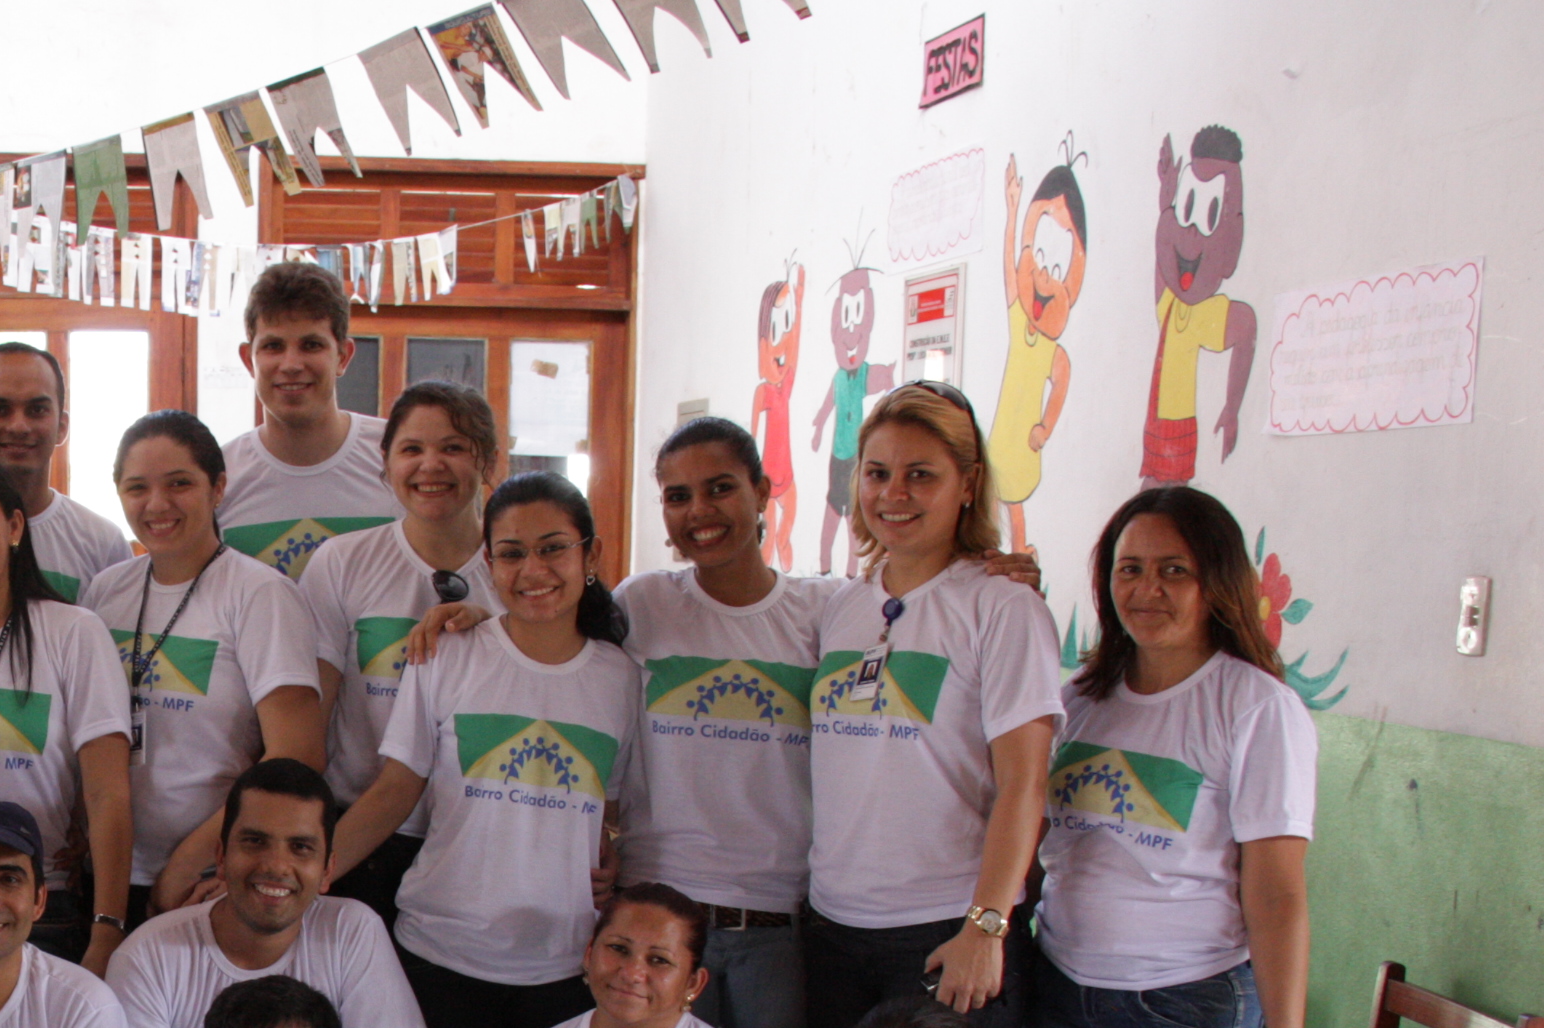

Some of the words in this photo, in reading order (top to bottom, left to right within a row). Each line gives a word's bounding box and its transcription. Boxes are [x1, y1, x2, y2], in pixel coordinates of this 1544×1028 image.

[923, 29, 978, 97] FESTAS
[366, 682, 398, 697] Bairro
[162, 697, 194, 713] MPF
[652, 720, 695, 737] Bairro
[702, 722, 770, 742] Cidadão
[784, 733, 809, 747] MP
[832, 721, 879, 737] Cidadão
[889, 725, 919, 741] MPF
[5, 757, 34, 770] MPF
[509, 789, 567, 810] Cidadão
[1135, 831, 1174, 851] MPF
